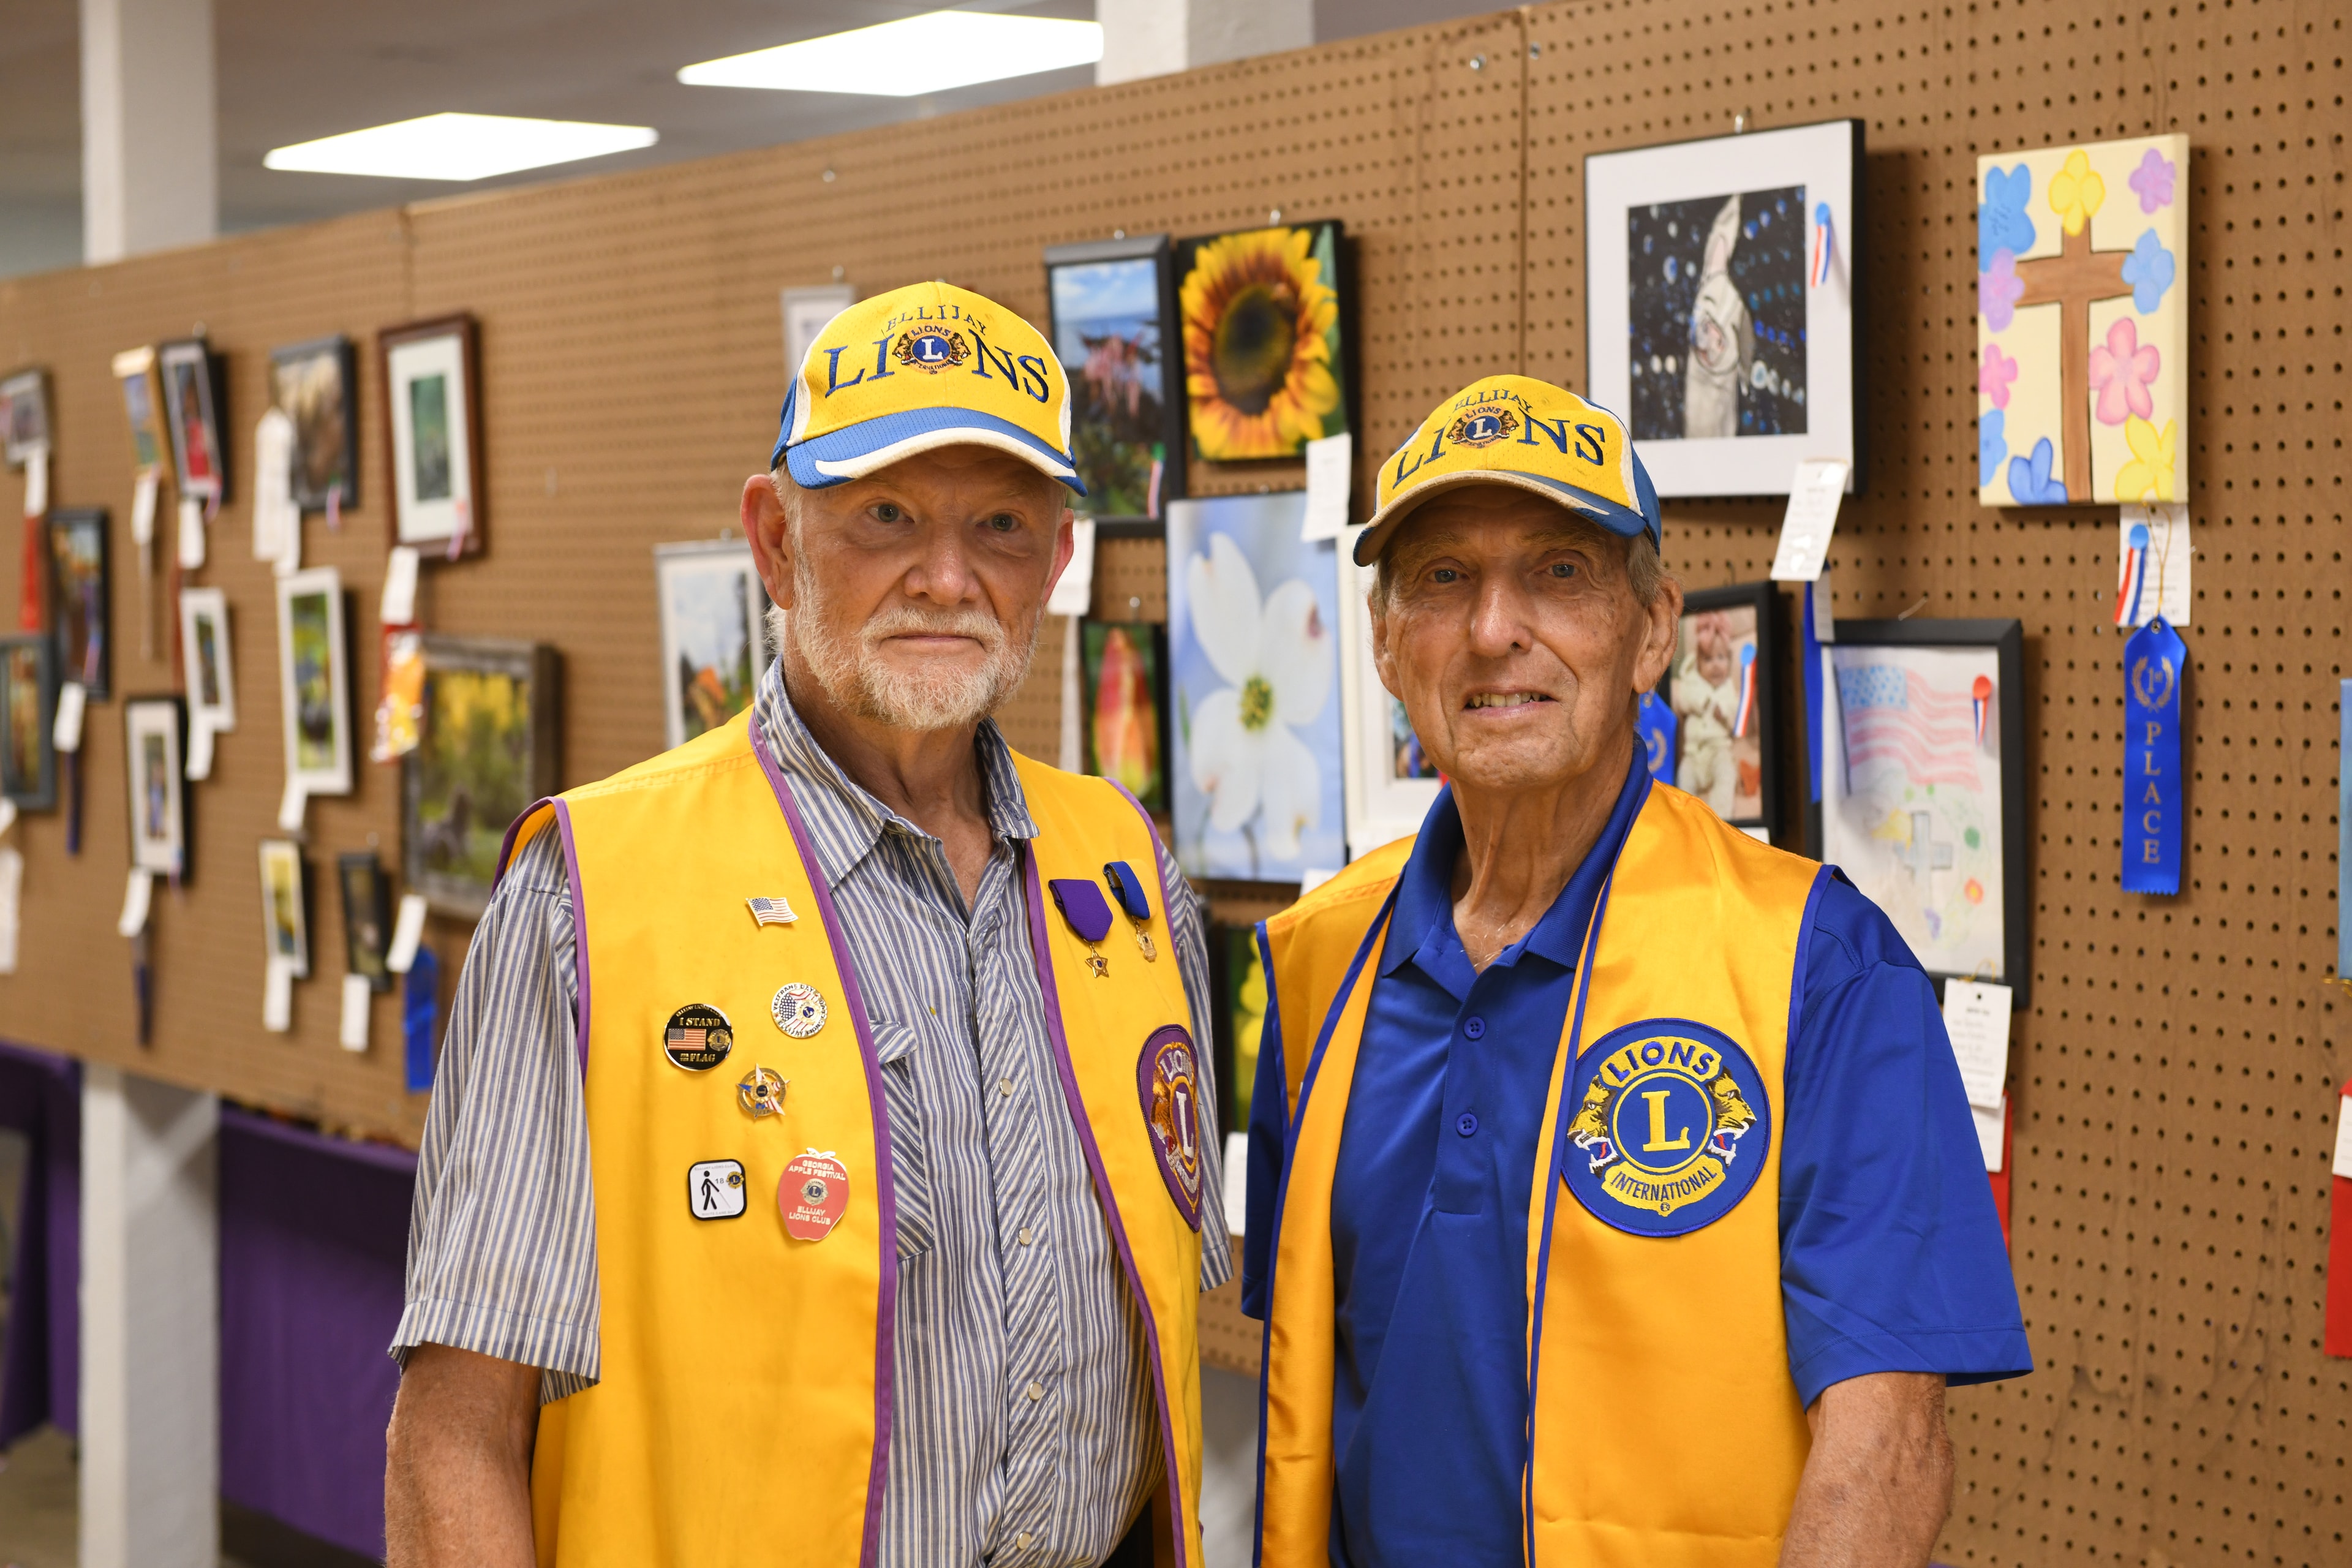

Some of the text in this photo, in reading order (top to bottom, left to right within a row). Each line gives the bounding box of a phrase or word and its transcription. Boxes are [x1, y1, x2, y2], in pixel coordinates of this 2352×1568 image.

[886, 304, 987, 336] ELLIJAY
[911, 325, 952, 336] LIONS
[921, 337, 944, 360] L
[1452, 389, 1534, 413] ELLIJAY
[1464, 406, 1502, 420] LIONS
[1472, 418, 1493, 439] L
[2143, 720, 2162, 864] PLACE
[679, 1017, 721, 1027] I STAND
[689, 1053, 716, 1062] FLAG
[1606, 1041, 1714, 1082] LIONS
[1175, 1091, 1194, 1159] L
[1641, 1090, 1691, 1152] L
[788, 1165, 846, 1182] APPLE FESTIVAL
[802, 1159, 835, 1172] GEORGIA
[812, 1186, 819, 1197] L
[1610, 1166, 1718, 1202] INTERNATIONAL
[788, 1212, 831, 1226] LIONS CLUB
[797, 1205, 826, 1216] ELLIJAY
